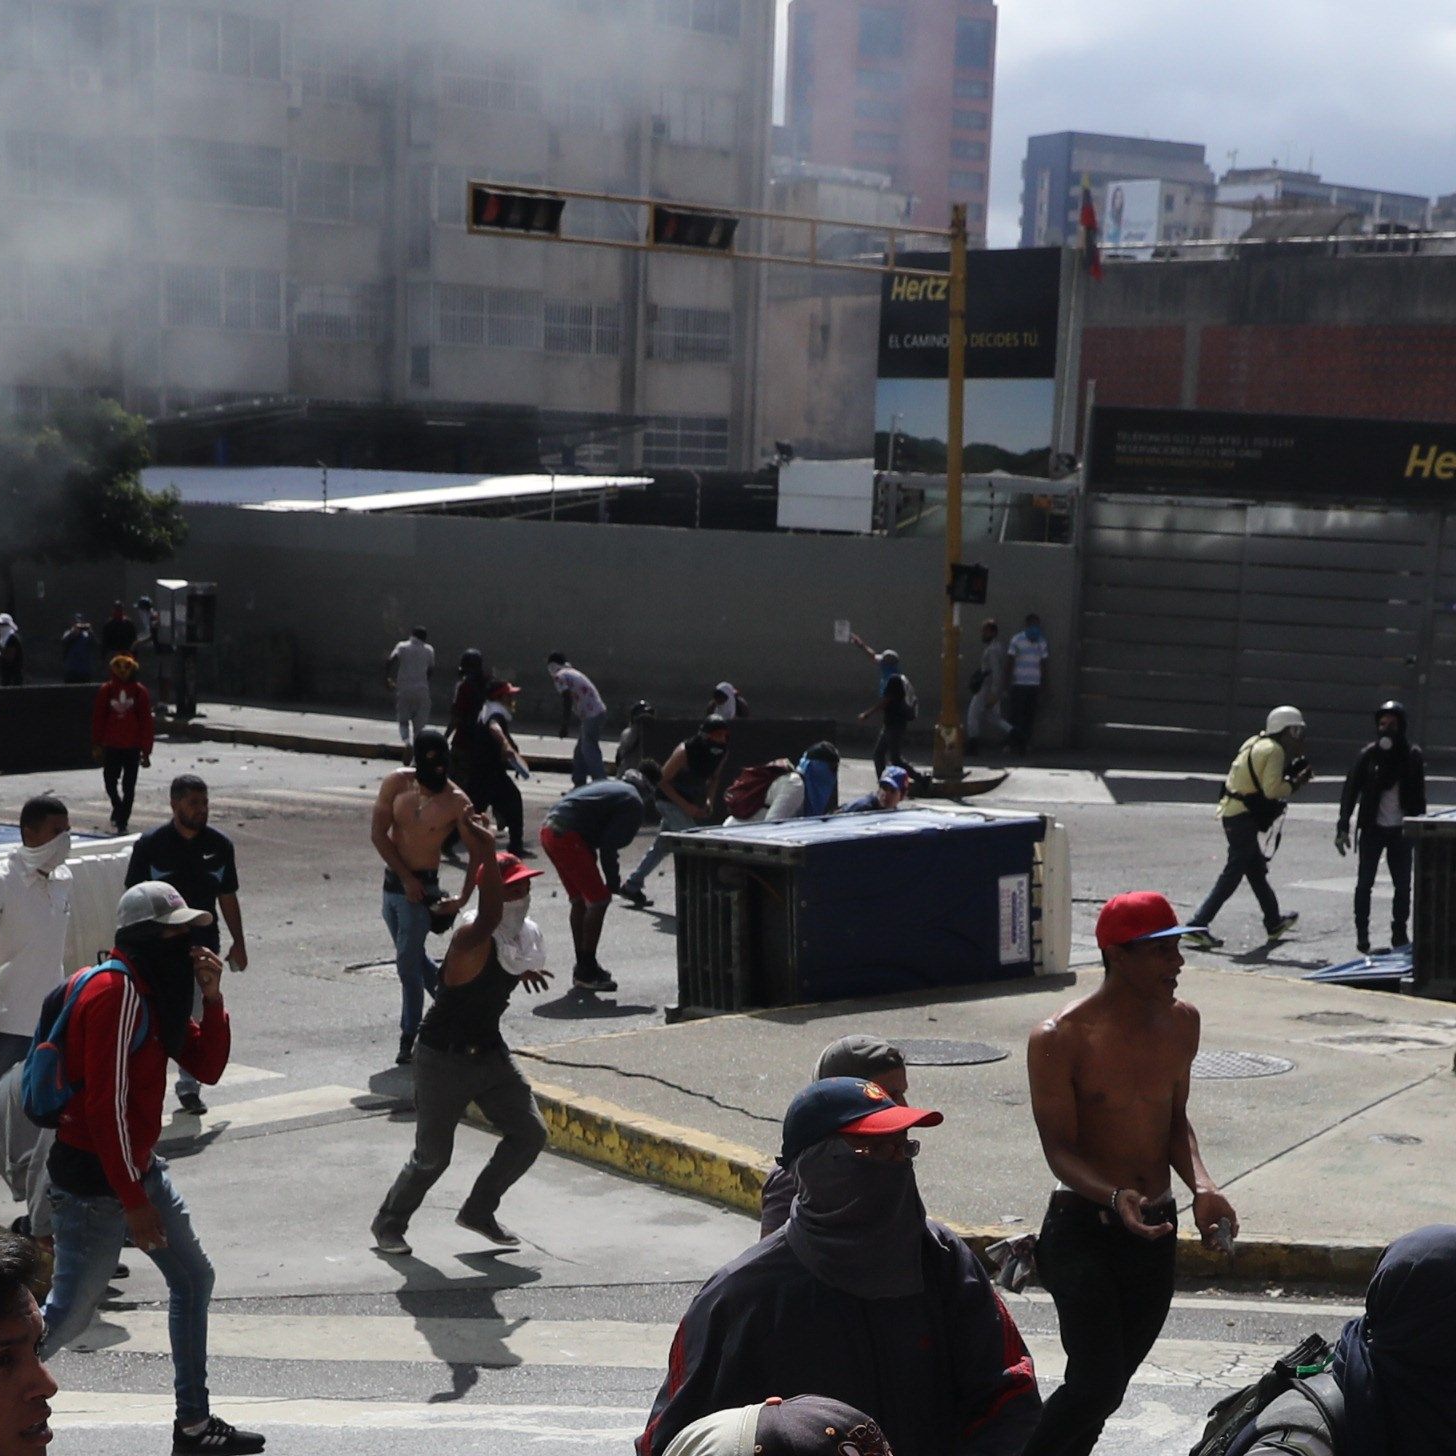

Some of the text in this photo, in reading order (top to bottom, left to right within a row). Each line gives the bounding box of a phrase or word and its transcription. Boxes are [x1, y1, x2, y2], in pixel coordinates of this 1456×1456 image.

[890, 274, 949, 302] Hertz
[889, 333, 900, 349] EL
[904, 333, 950, 349] CAMINO
[971, 332, 1019, 348] DECIDES
